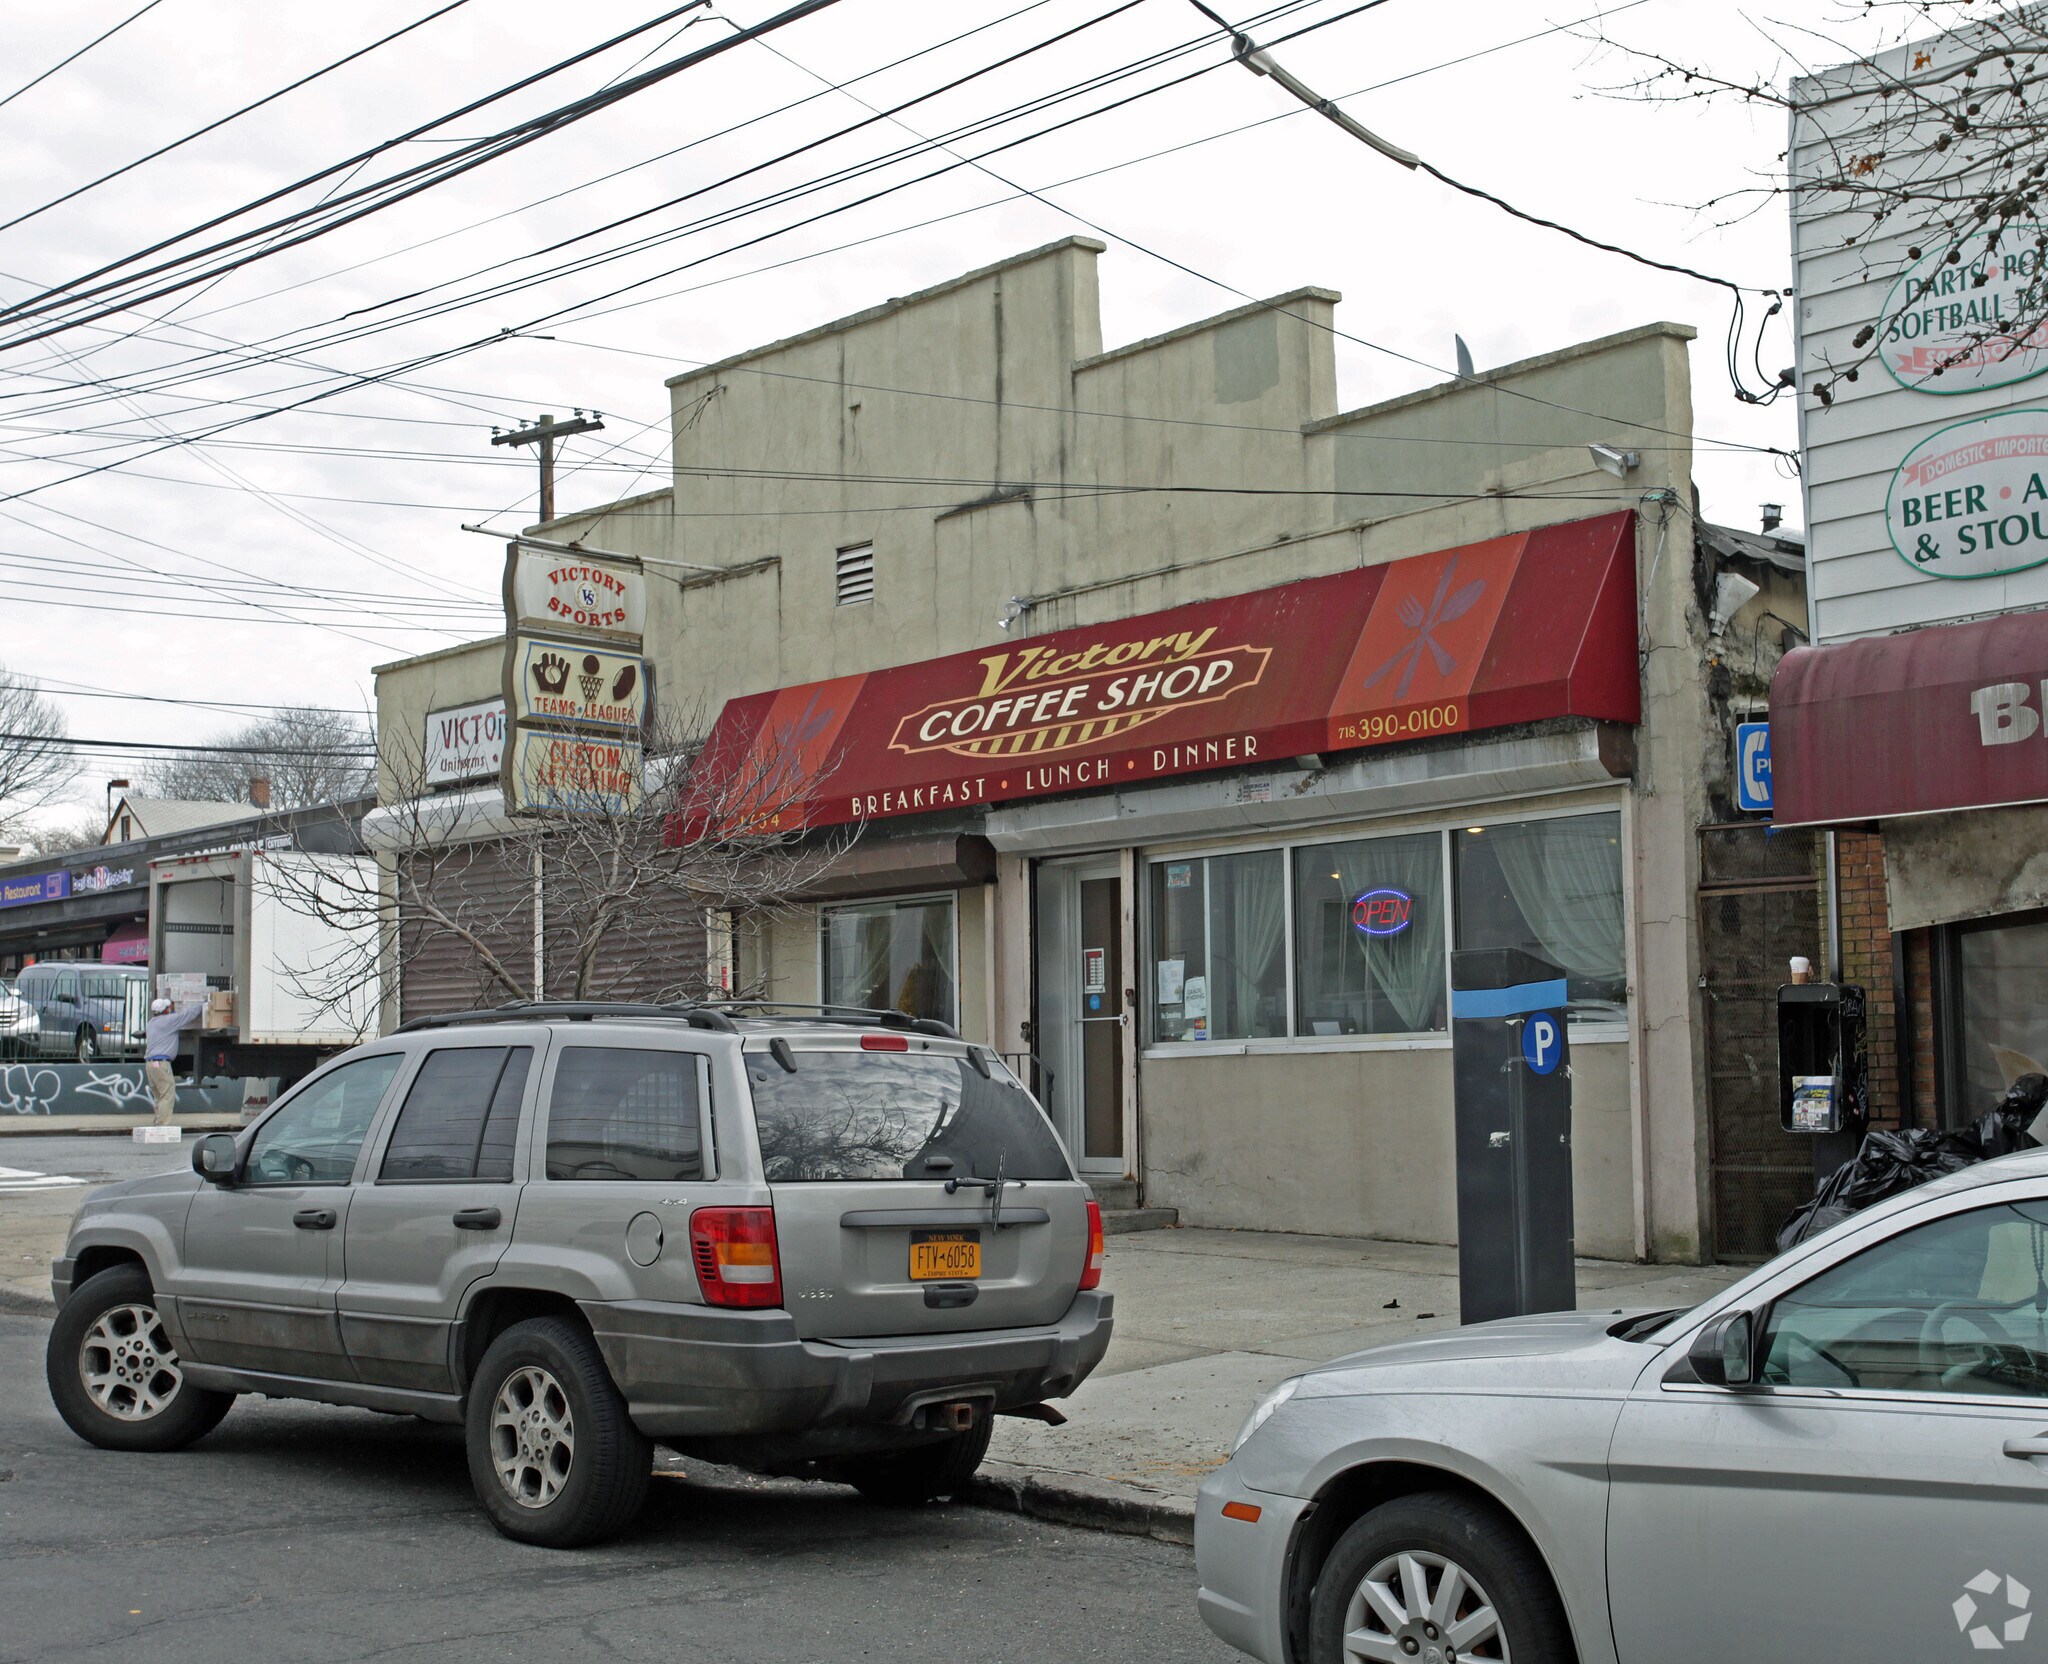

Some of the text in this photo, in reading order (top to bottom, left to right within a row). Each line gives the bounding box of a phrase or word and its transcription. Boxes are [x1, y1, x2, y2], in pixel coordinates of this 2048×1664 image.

[1905, 262, 1986, 305] DARTS
[1889, 293, 2005, 344] SOFTBALL
[1925, 444, 1986, 481] DOMESTIC
[1902, 484, 1989, 528] BEER
[1914, 510, 2048, 563] & STOU
[547, 566, 626, 597] VICTORY
[581, 588, 595, 606] VS
[546, 596, 626, 627] SPORTS
[977, 626, 1218, 699] Victory
[534, 696, 635, 723] TEAMS LEAGUES
[919, 659, 1234, 742] COFFEE SHOP
[1338, 704, 1459, 740] 718 390-0100
[549, 740, 620, 770] CUSTOM
[851, 735, 1258, 817] BREAKFAST LUNCH DINNER
[4, 882, 42, 901] Restaurant
[1353, 898, 1412, 925] OPEN
[1534, 1020, 1555, 1067] P
[928, 1233, 965, 1242] NEW YORK
